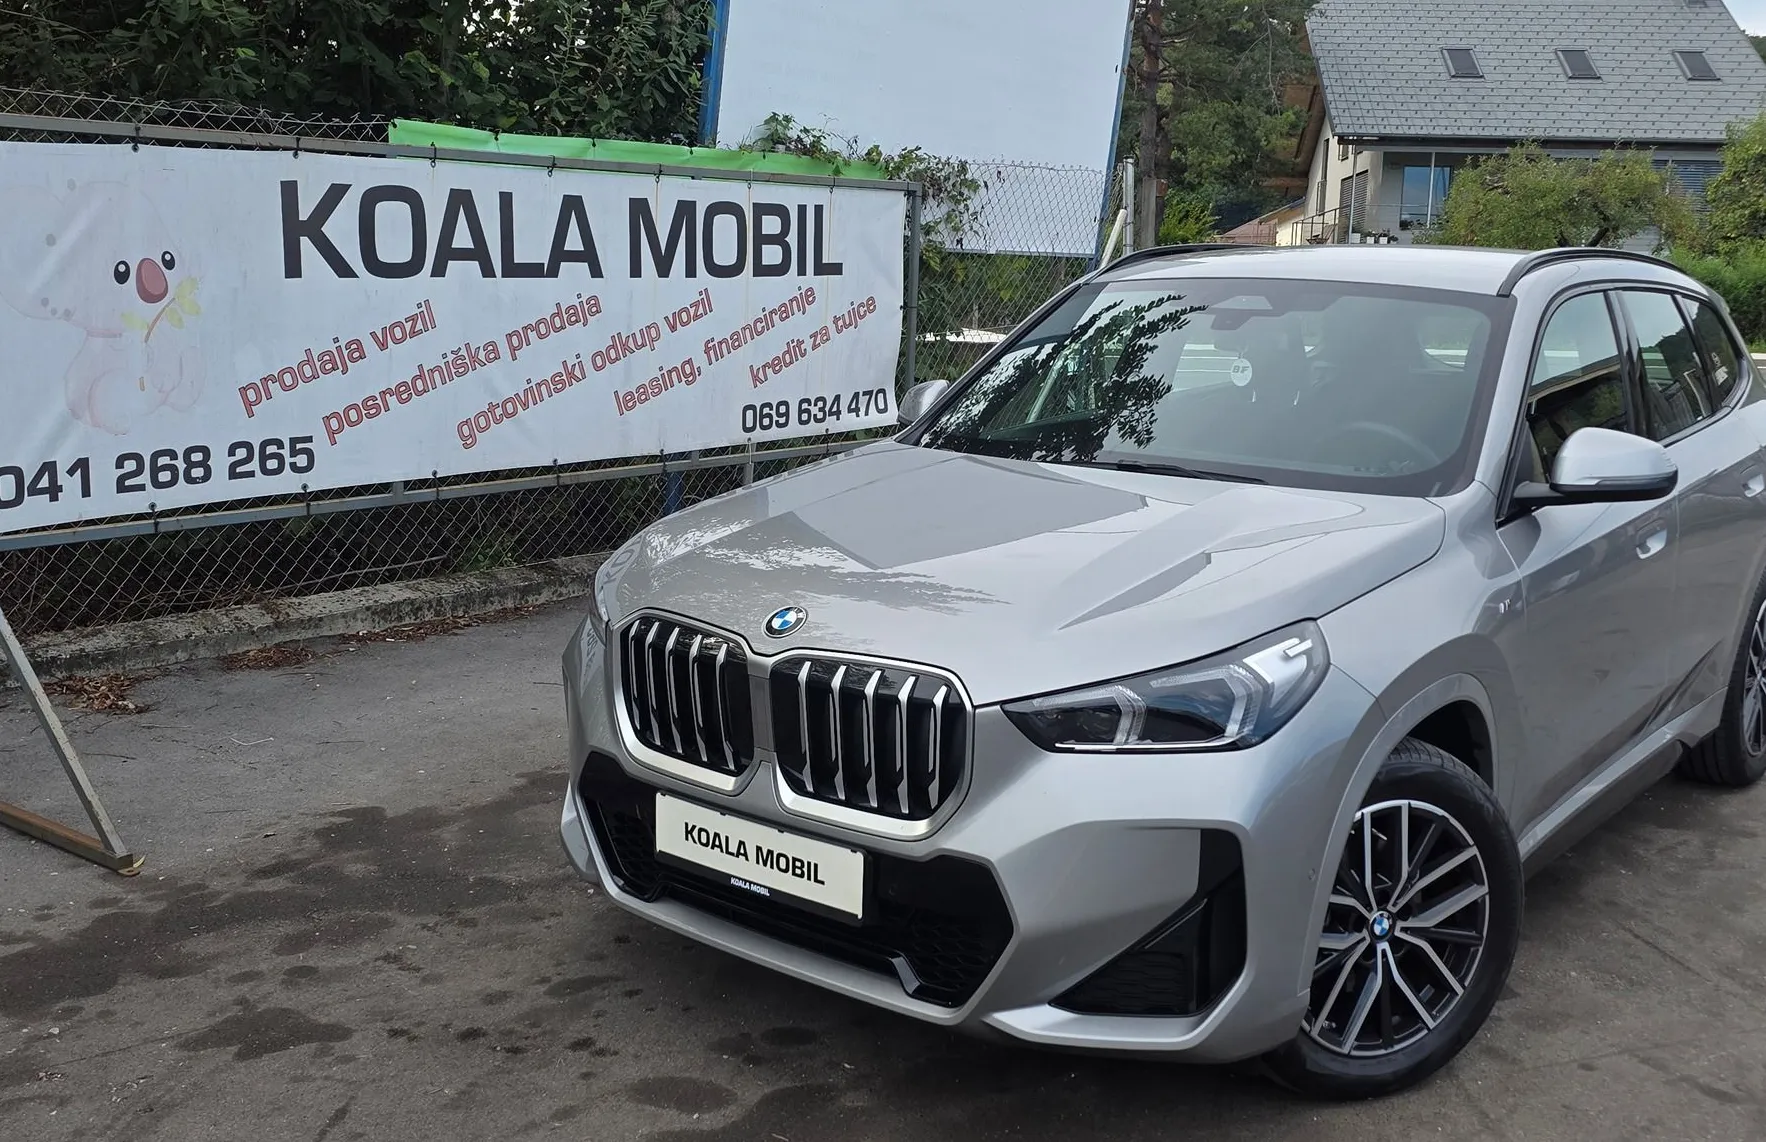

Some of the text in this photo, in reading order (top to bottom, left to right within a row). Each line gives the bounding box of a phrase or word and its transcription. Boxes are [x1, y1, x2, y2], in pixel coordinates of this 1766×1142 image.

[280, 180, 843, 279] KOALA MOBIL
[238, 299, 437, 418] prodaja vozil
[322, 293, 602, 445] posredniška prodaja
[456, 288, 714, 450] gotovinski odkup vozil
[613, 285, 817, 416] leasing, financiranje
[749, 295, 877, 388] kredit za tujce
[742, 388, 888, 433] 069 634 470
[0, 435, 315, 509] 041 268 265
[684, 822, 825, 885] KOALA MOBIL
[730, 876, 770, 897] KOALA MOBIL
